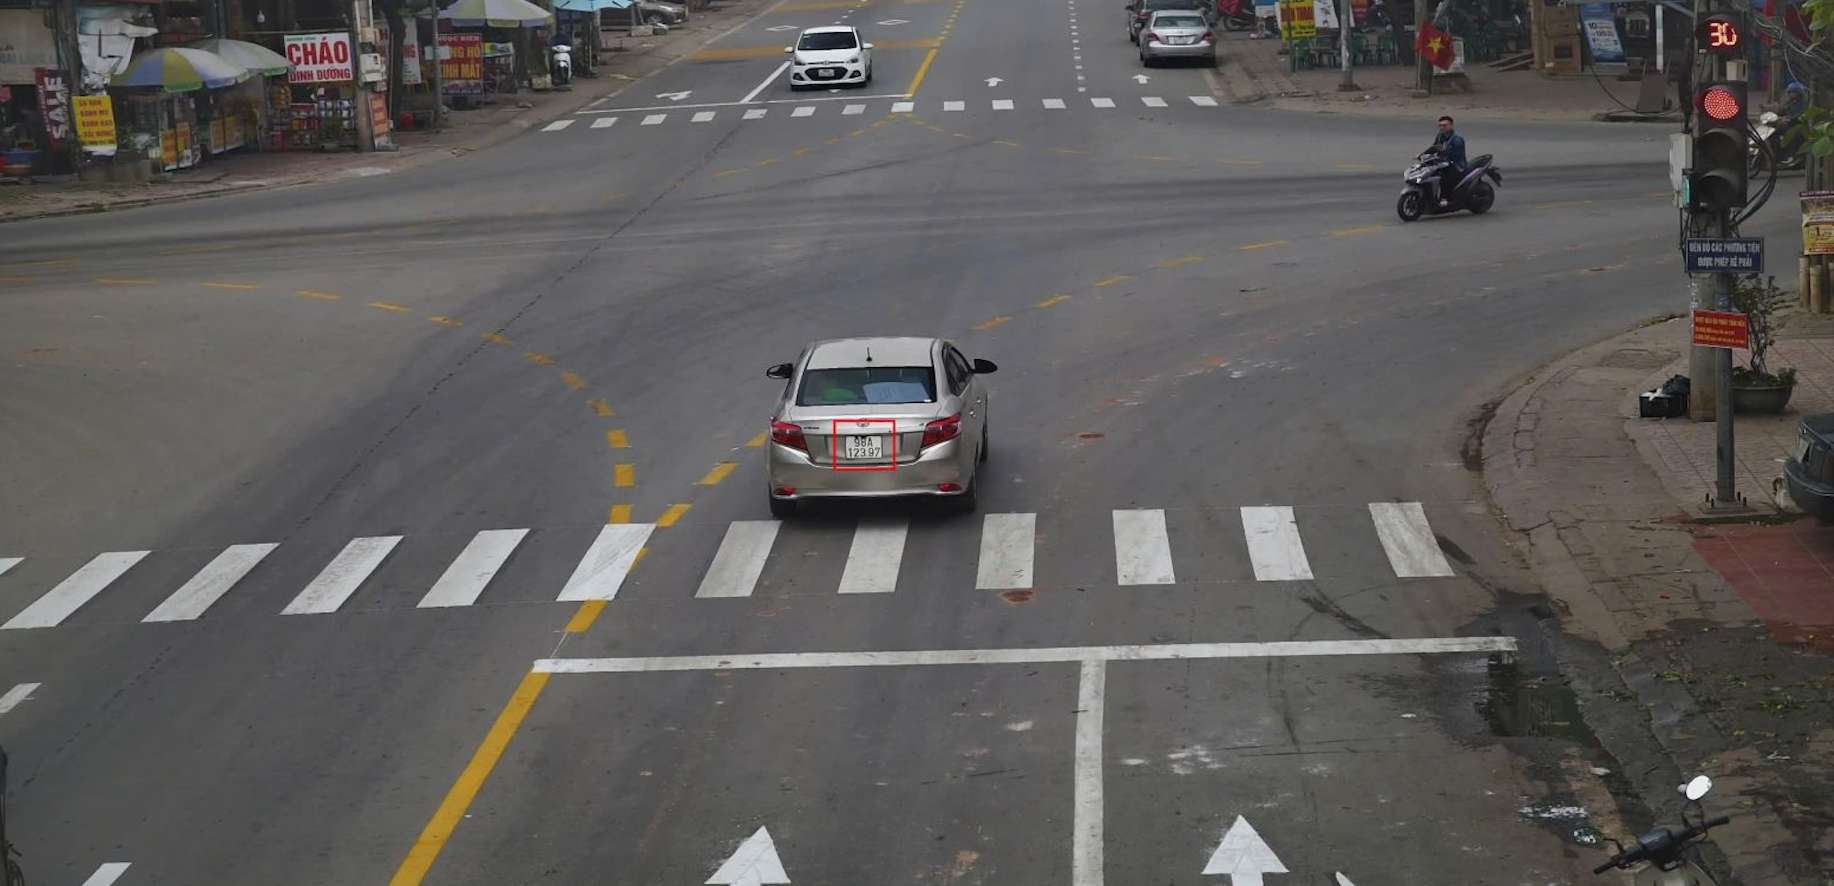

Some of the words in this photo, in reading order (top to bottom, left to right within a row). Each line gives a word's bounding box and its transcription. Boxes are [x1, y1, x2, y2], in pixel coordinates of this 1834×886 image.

[1710, 22, 1737, 46] 30
[287, 36, 349, 65] CHÁO
[44, 76, 67, 139] SALE
[854, 437, 873, 447] 98A
